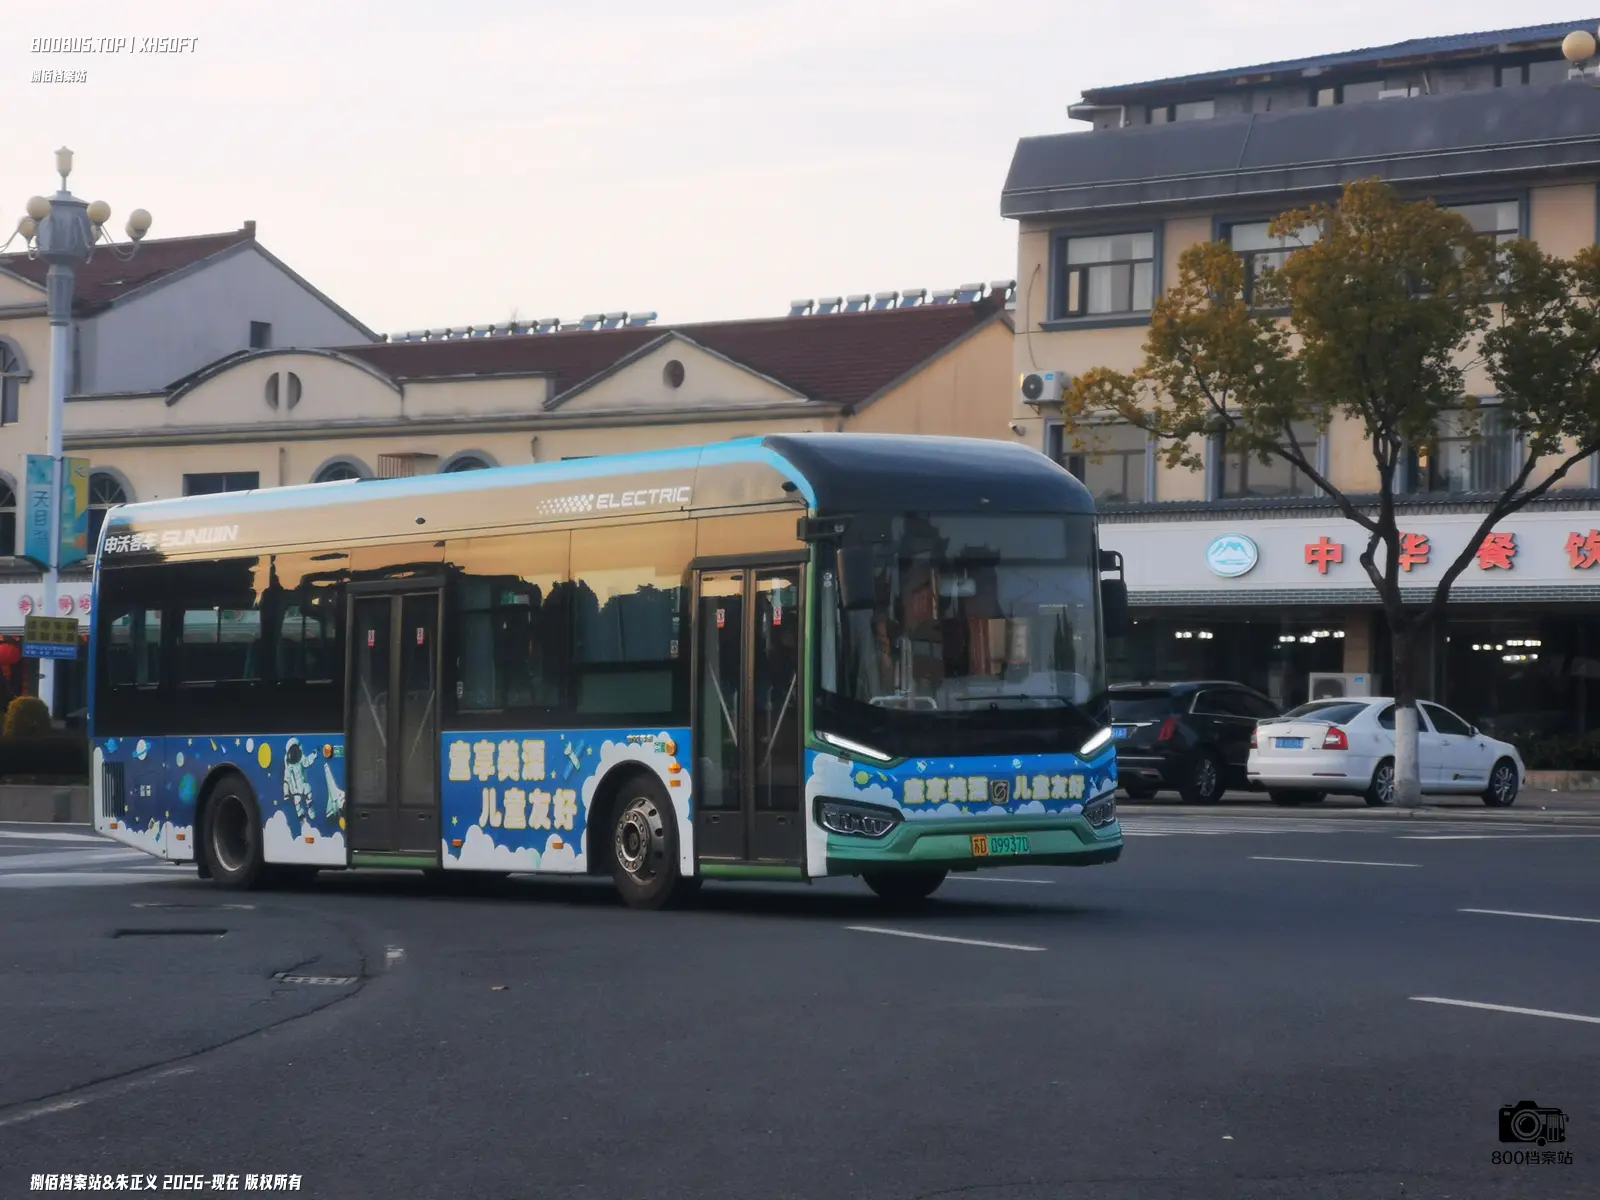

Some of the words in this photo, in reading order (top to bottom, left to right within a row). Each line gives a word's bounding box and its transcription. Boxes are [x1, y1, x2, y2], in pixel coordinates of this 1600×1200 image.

[596, 486, 691, 509] ELECTRIC
[104, 534, 157, 554] 申沃客车
[161, 526, 238, 547] SUNWIN
[1013, 774, 1086, 800] 儿童友好
[478, 787, 578, 830] 儿童友好
